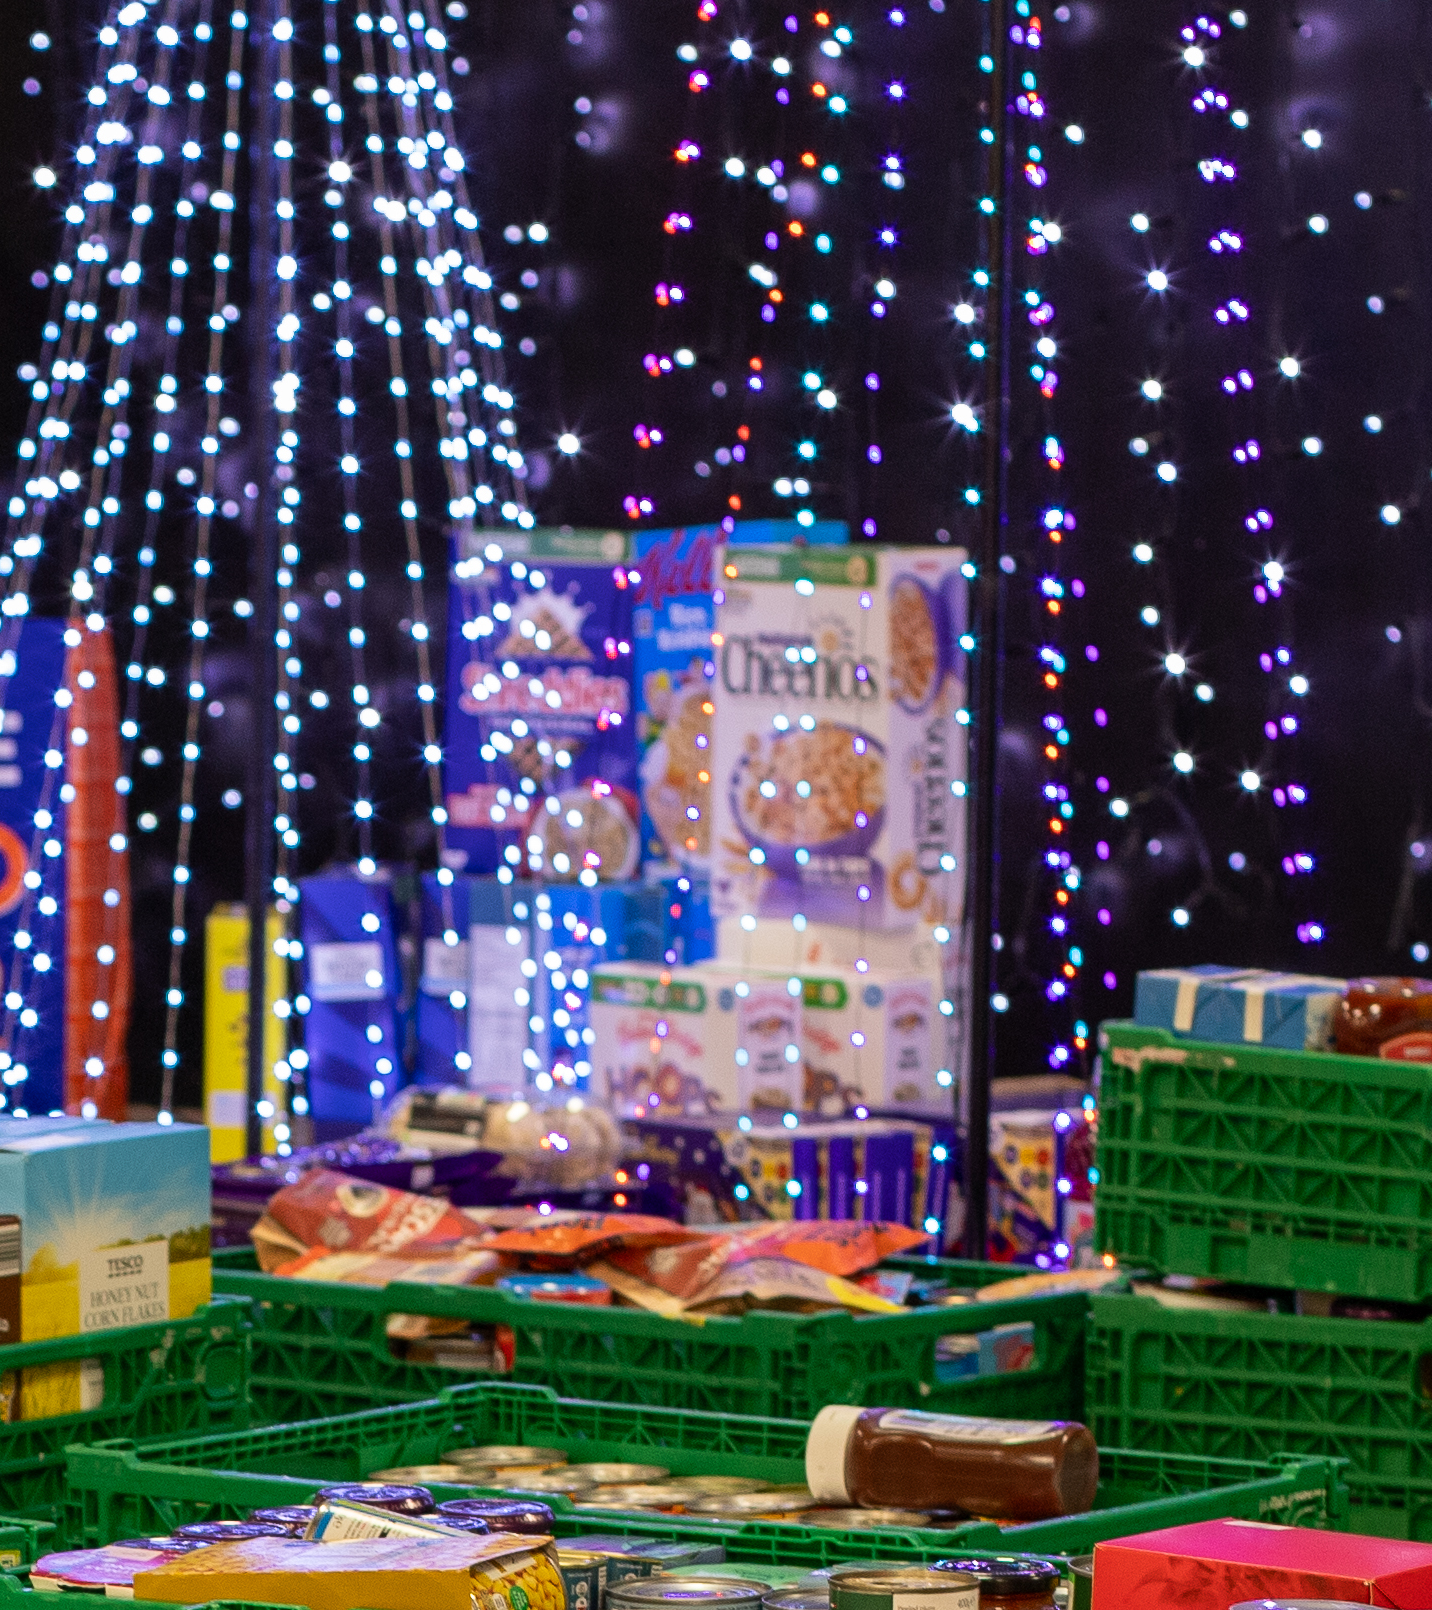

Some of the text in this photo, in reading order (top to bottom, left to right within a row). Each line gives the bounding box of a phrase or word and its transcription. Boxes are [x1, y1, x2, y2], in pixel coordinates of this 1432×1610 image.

[107, 1254, 143, 1274] TESCO
[89, 1283, 160, 1308] HONEY NUT
[83, 1305, 119, 1329] CORN
